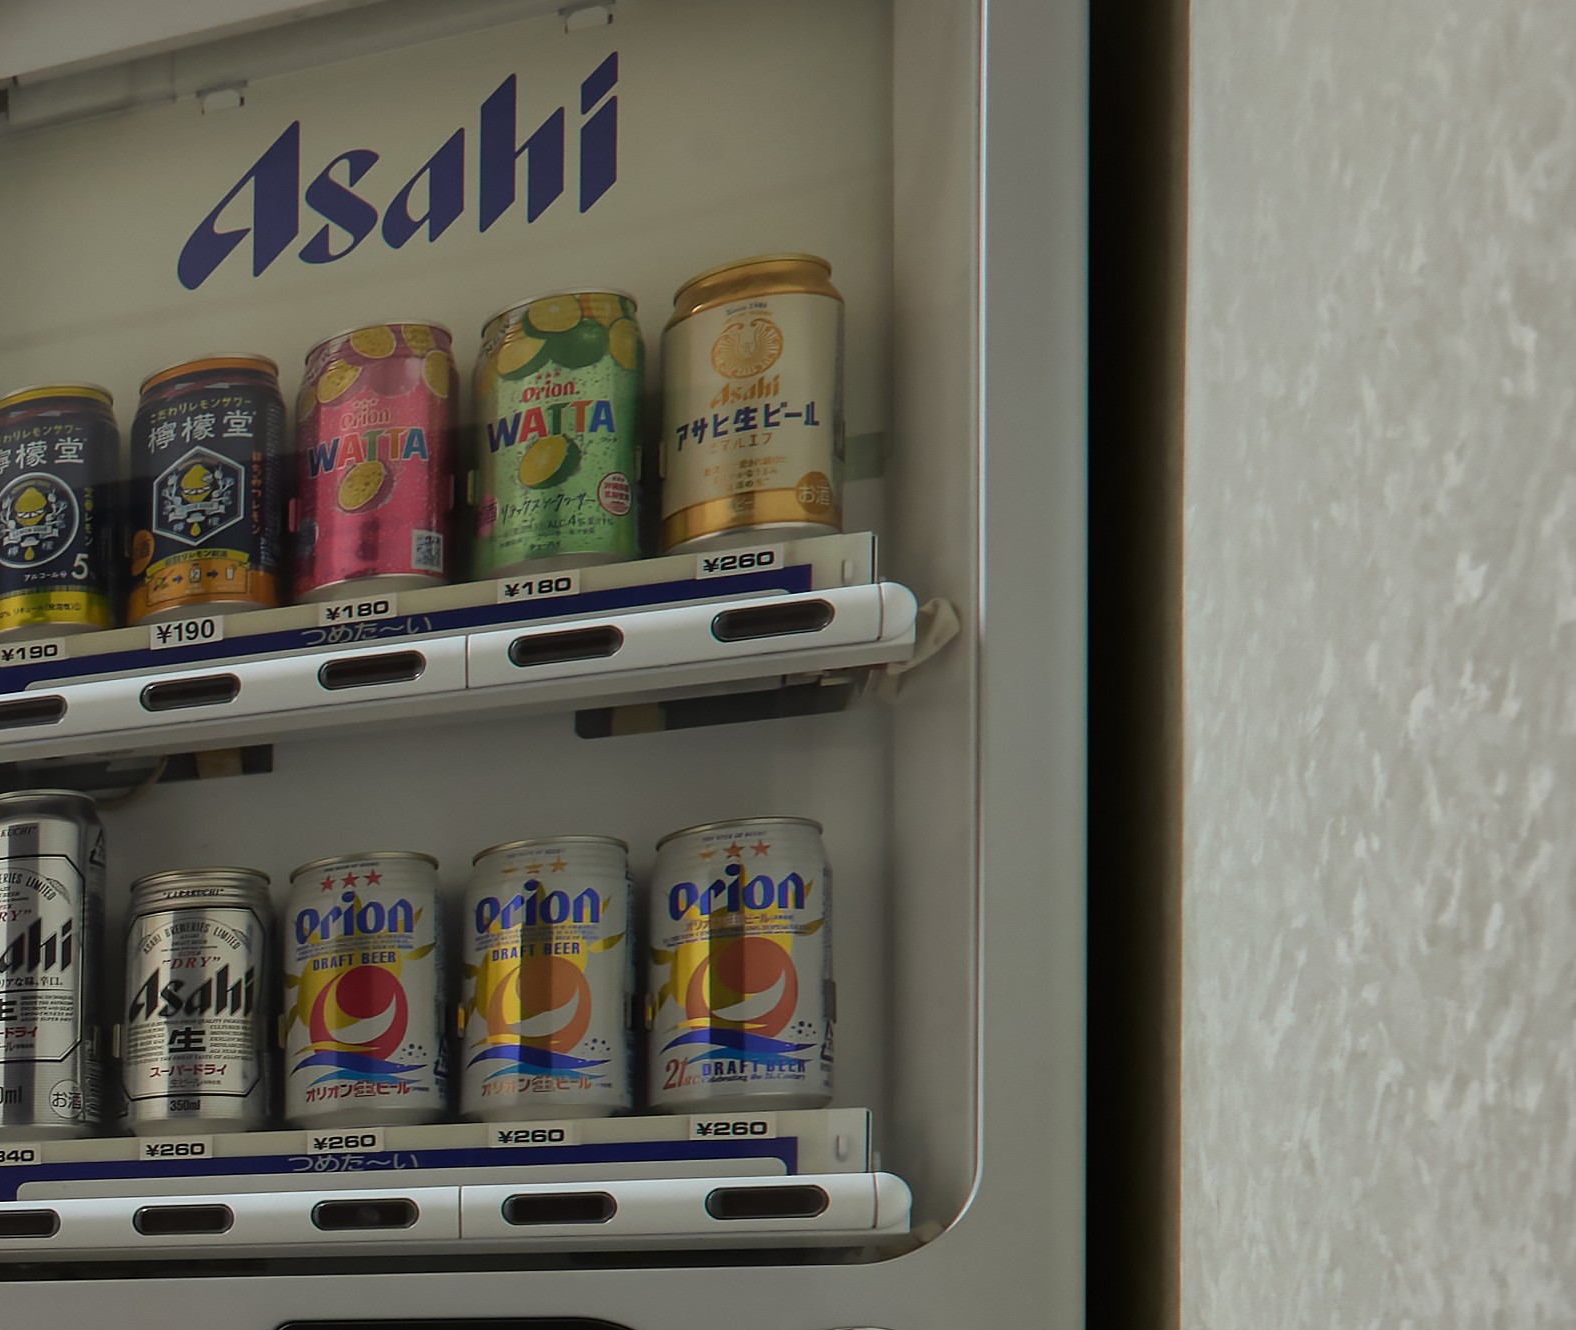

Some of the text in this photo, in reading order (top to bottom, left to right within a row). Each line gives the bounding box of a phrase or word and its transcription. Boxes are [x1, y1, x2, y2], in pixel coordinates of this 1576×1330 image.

[177, 50, 619, 290] Asahi
[487, 401, 616, 453] WATTA
[676, 401, 819, 451] アサヒ生ビール
[308, 427, 429, 477] WATTA
[704, 551, 775, 572] ¥260
[505, 576, 571, 596] ¥180
[326, 599, 389, 620] ¥180
[157, 620, 215, 643] ¥190
[2, 644, 58, 661] ¥190
[313, 951, 396, 971] DRAFT BEER
[130, 964, 255, 1022] Asahi
[168, 1027, 206, 1053] 生
[150, 1064, 227, 1078] スーパードライ
[702, 1057, 807, 1077] DRAFT BEER
[52, 1091, 82, 1111] お酒
[697, 1121, 768, 1137] ¥260
[314, 1134, 377, 1150] ¥260
